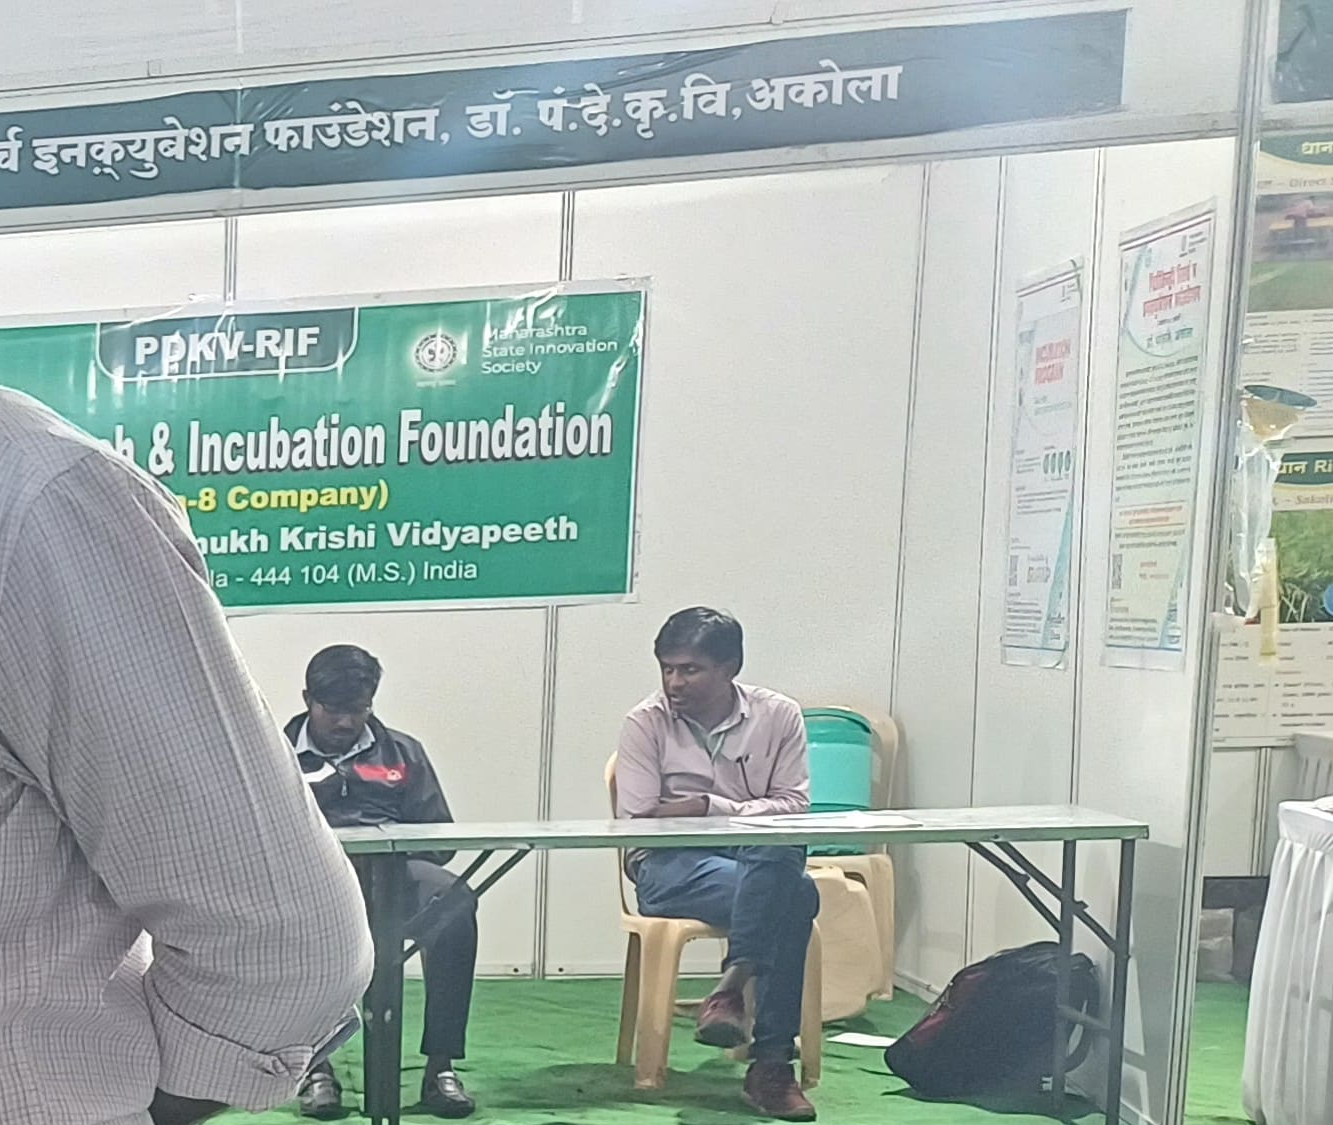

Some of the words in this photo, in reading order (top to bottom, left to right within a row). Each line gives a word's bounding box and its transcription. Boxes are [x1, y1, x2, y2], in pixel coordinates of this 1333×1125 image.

[465, 88, 521, 140] डॉ.
[135, 326, 321, 364] PDKV-RIF
[482, 343, 525, 359] State
[530, 338, 618, 355] Innovation
[482, 359, 541, 374] Society
[148, 421, 175, 477] &
[188, 412, 385, 474] Incubation
[399, 401, 612, 464] Foundation
[227, 479, 389, 513] Company)
[280, 524, 375, 553] Krishi
[386, 515, 578, 551] Vidyapeeth
[250, 566, 292, 586] 444
[300, 564, 340, 585] 104
[347, 561, 415, 587] (M.S.)
[423, 561, 477, 582] India
